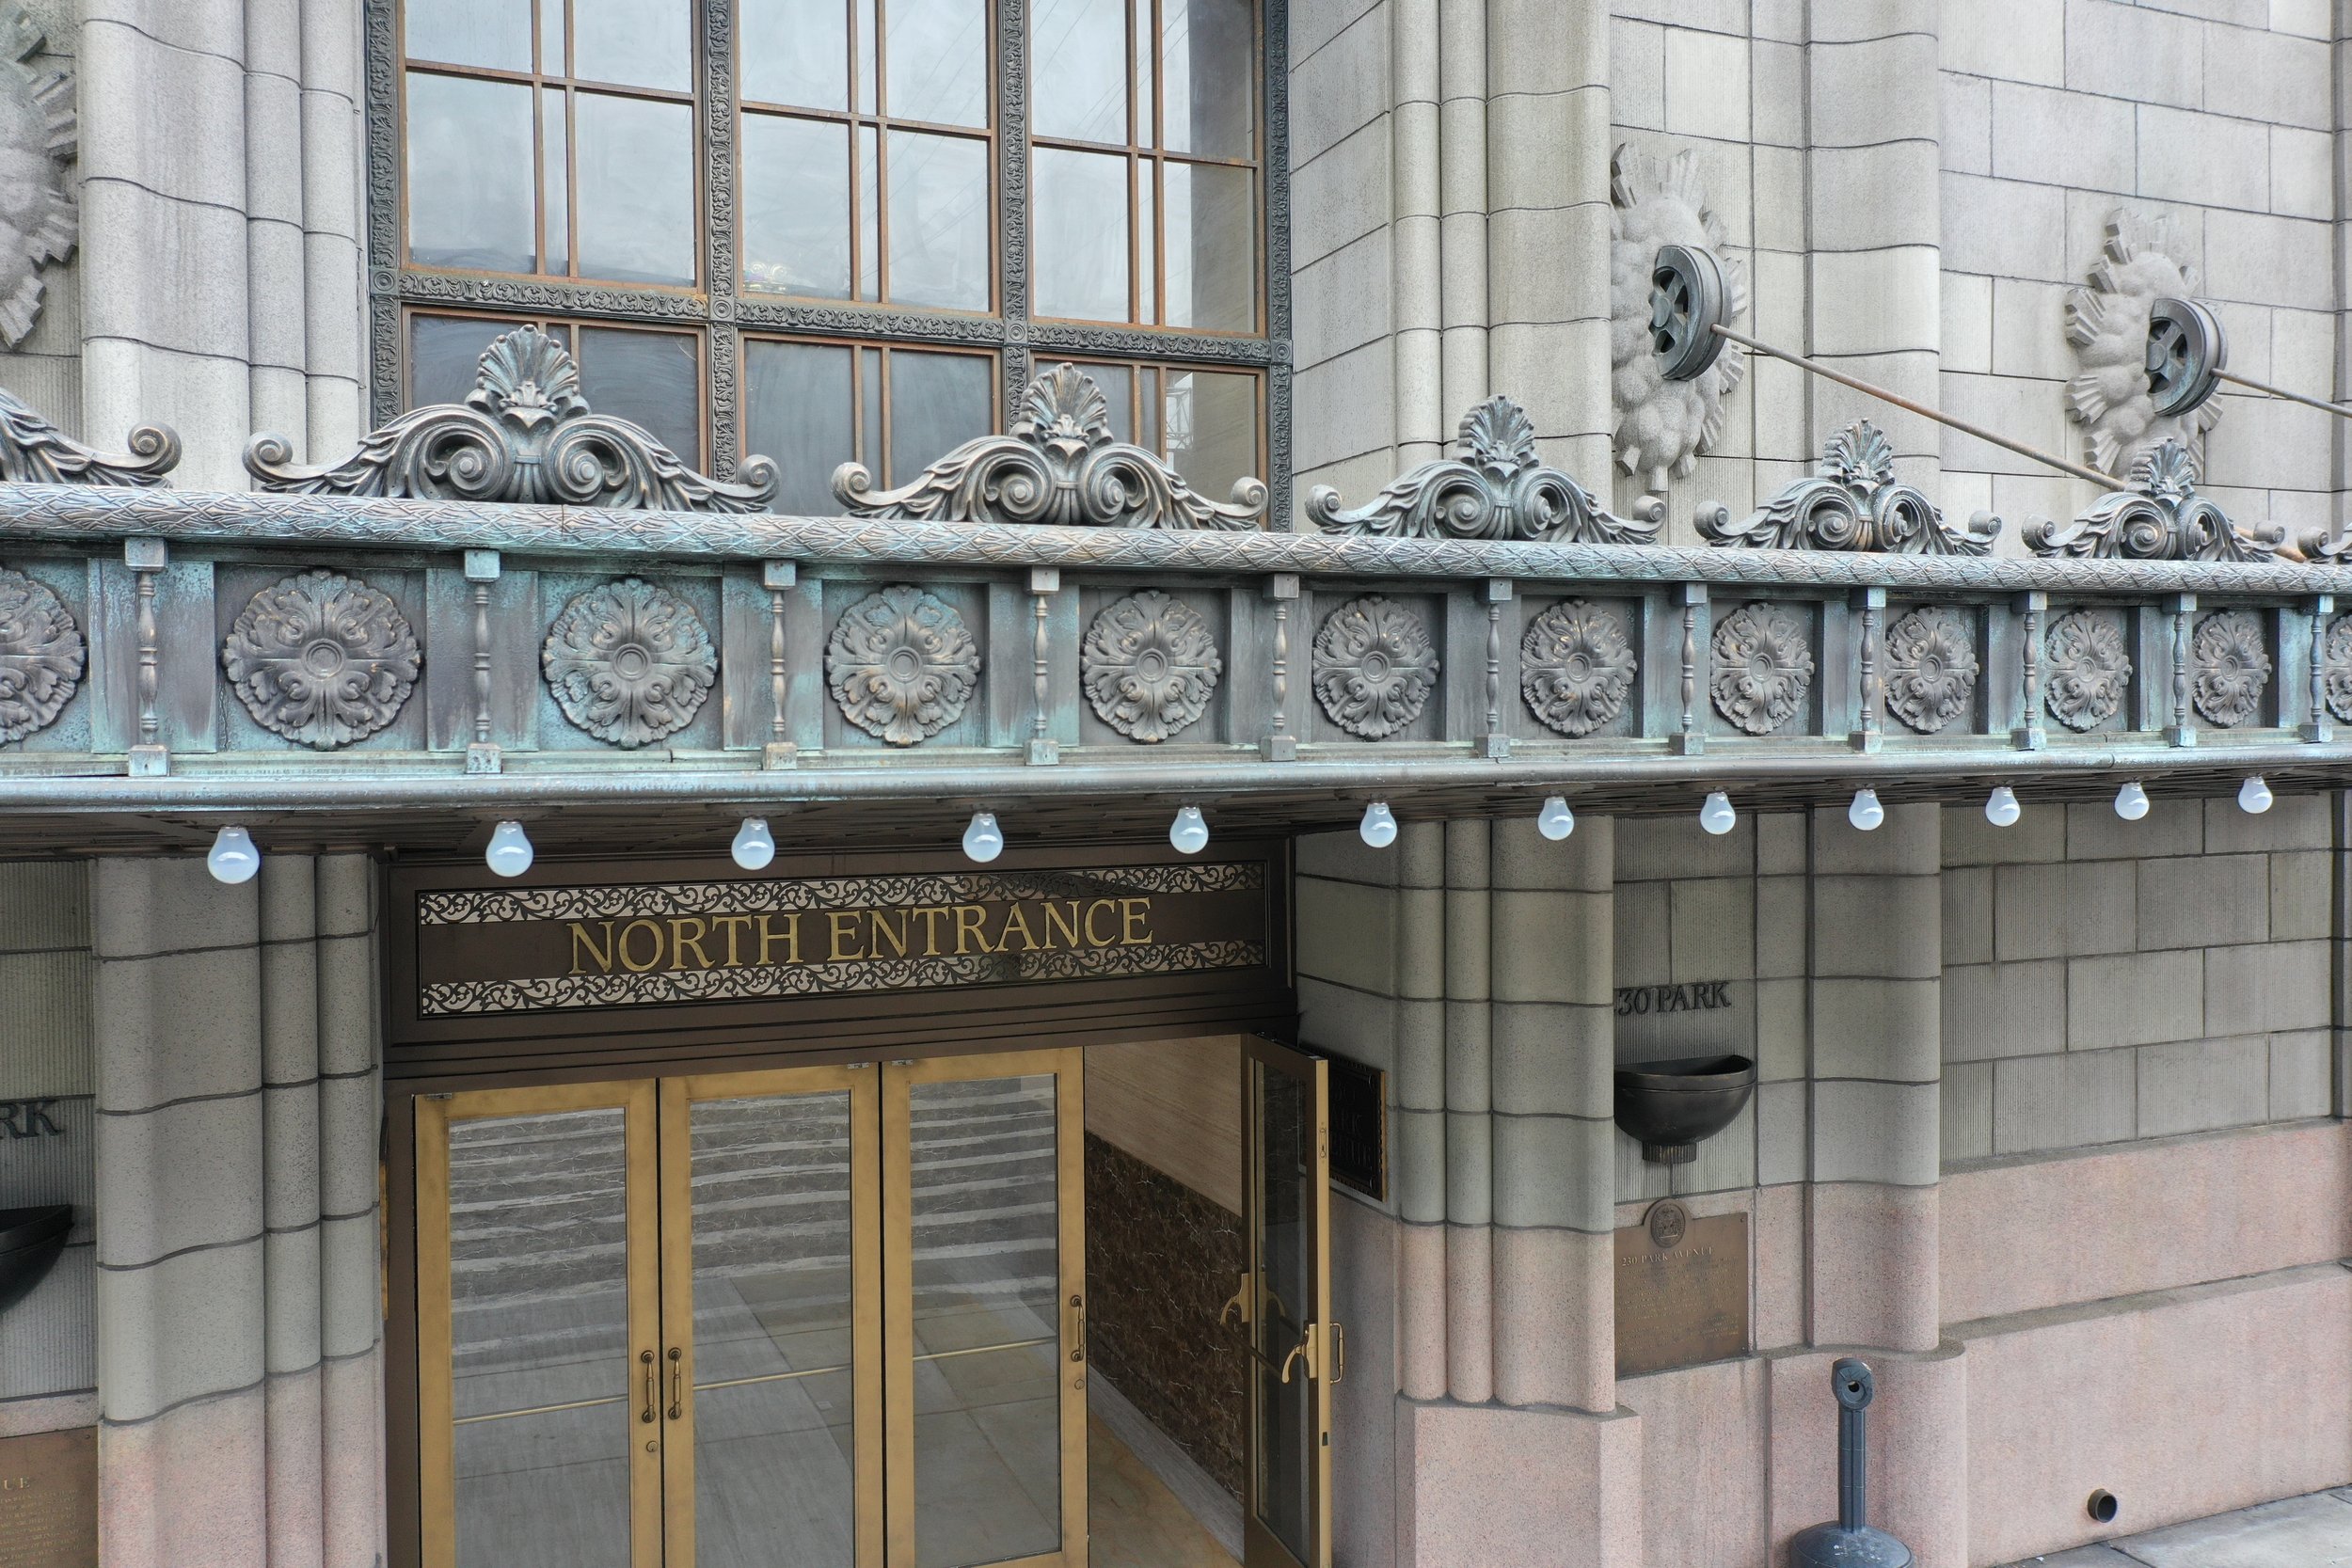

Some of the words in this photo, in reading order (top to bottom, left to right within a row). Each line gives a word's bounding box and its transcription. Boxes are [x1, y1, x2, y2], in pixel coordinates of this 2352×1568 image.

[565, 912, 804, 974] NORTH
[824, 896, 1153, 961] ENTRANCE
[1614, 988, 1650, 1017] 30
[1656, 981, 1732, 1013] PARK
[1622, 1256, 1638, 1266] 230
[1641, 1252, 1668, 1263] PARK
[1674, 1245, 1713, 1259] AVENUE
